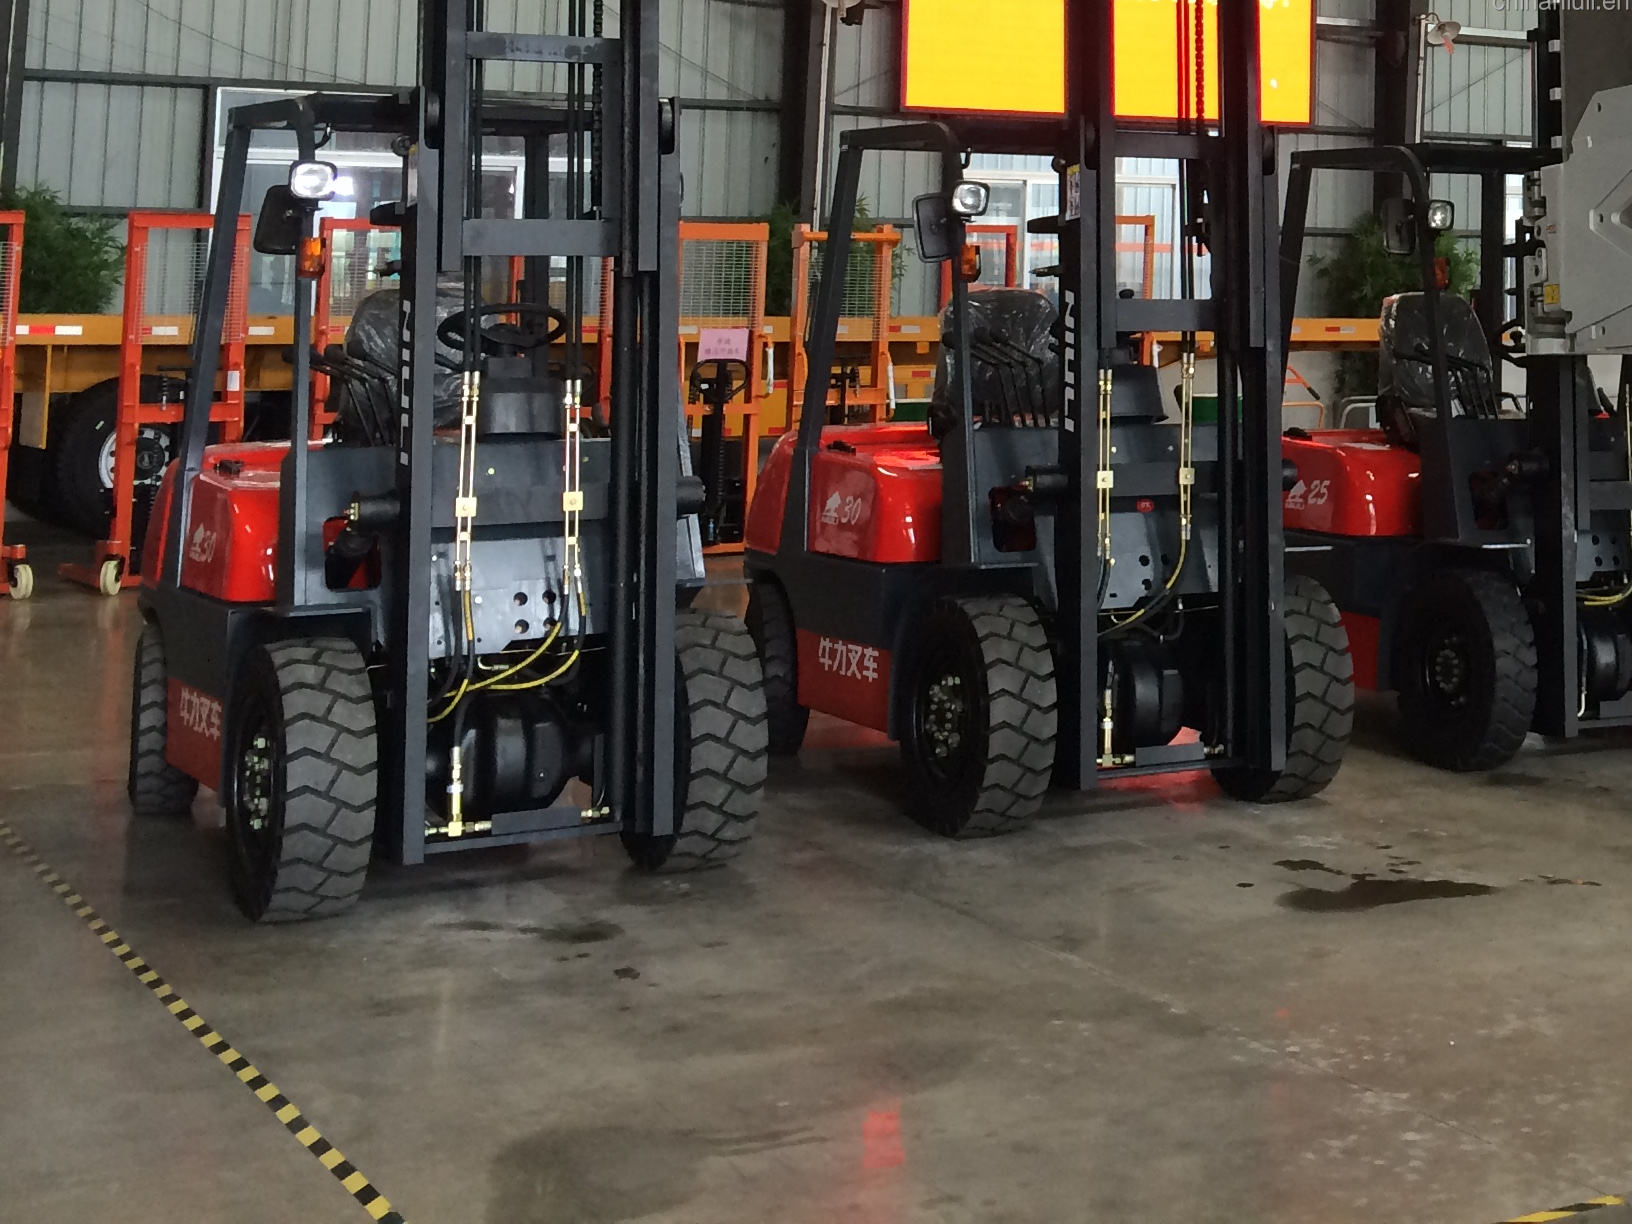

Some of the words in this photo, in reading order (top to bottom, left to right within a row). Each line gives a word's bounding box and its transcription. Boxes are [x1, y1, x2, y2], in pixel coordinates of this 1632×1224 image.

[400, 299, 411, 466] NIULI
[1064, 289, 1076, 433] NIULI
[841, 496, 862, 525] 30
[1307, 480, 1331, 504] 25
[818, 637, 879, 683] 牛力叉车
